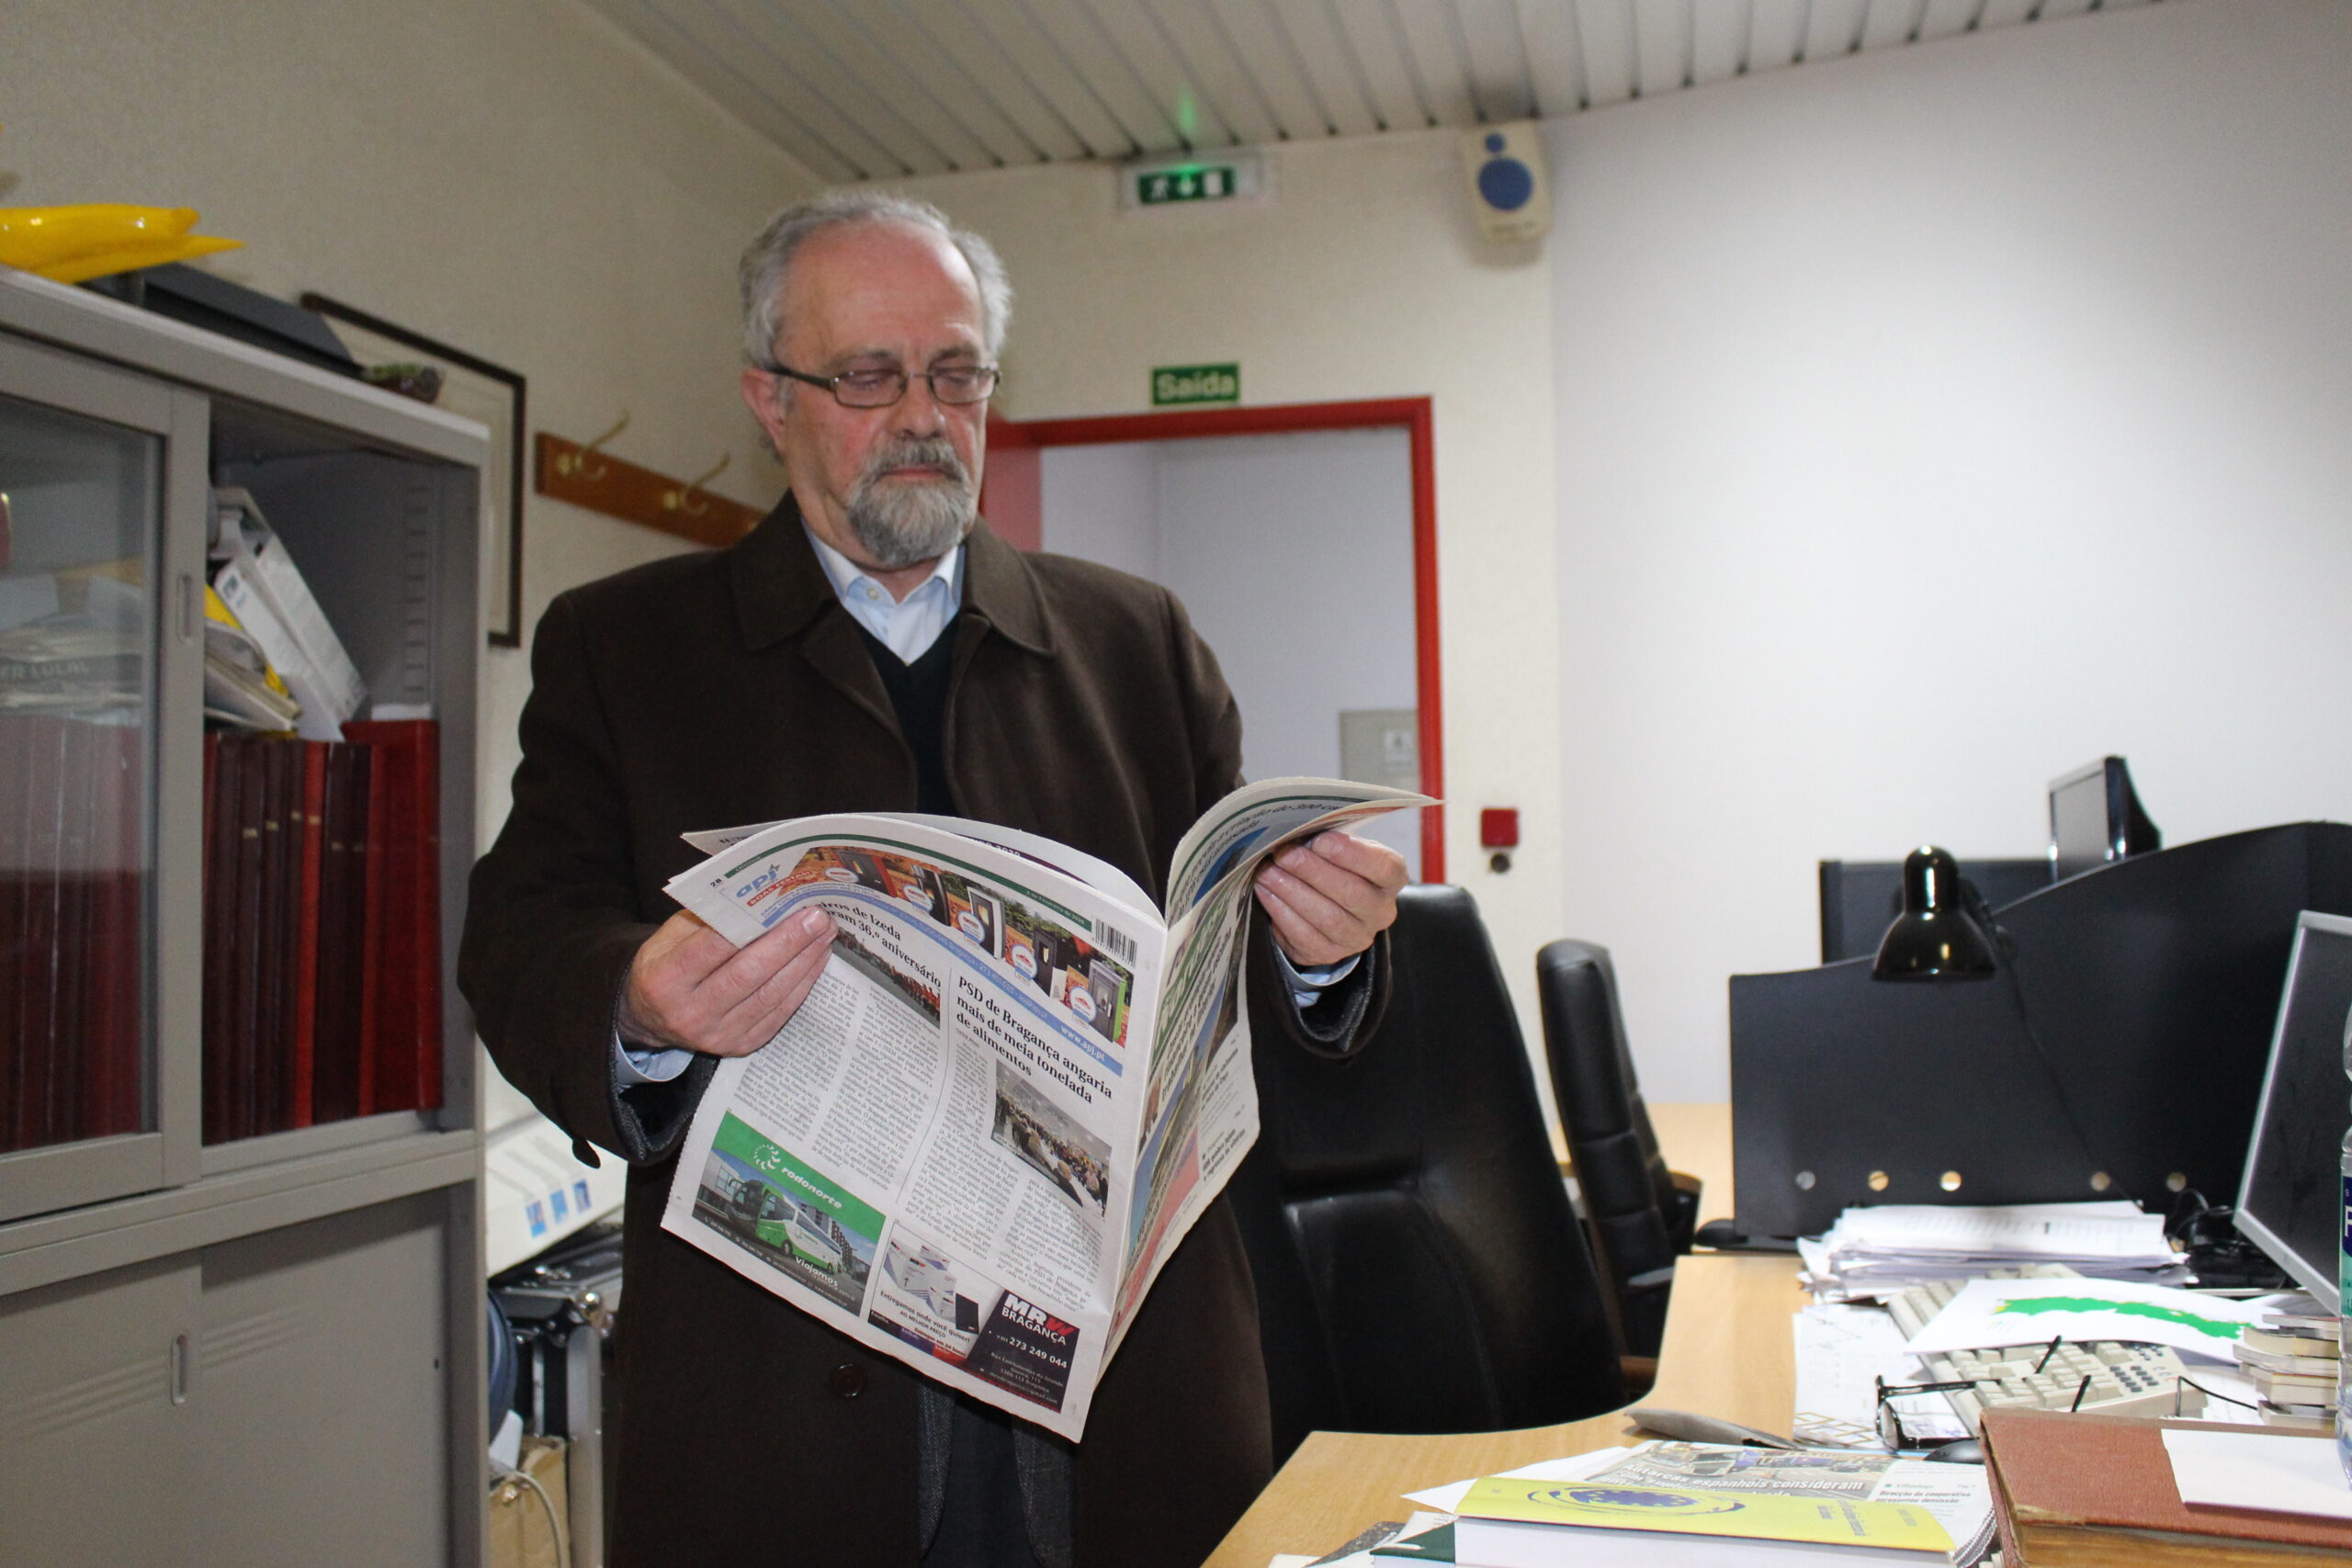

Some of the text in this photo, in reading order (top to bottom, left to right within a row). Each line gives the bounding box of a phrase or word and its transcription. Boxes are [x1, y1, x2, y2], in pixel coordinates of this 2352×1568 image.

[852, 906, 867, 918] de
[870, 912, 901, 942] Izeda
[882, 937, 942, 988] aniversário
[956, 1012, 971, 1028] de
[973, 1025, 1033, 1077] alimentos
[957, 997, 985, 1022] mais
[988, 1018, 1001, 1034] de
[1004, 1032, 1034, 1061] meia
[1037, 1056, 1092, 1104] tonelada
[959, 976, 983, 1003] PSD
[986, 998, 1000, 1015] de
[1003, 1012, 1060, 1062] Bragança
[1063, 1056, 1113, 1100] angaria
[1061, 1025, 1106, 1061] www.apj.pt
[782, 1167, 842, 1209] rodonorte
[796, 1256, 838, 1287] Viajamos
[880, 1290, 915, 1314] Entregamos
[916, 1311, 932, 1324] onde
[933, 1319, 947, 1330] você
[909, 1314, 929, 1330] MELHOR
[930, 1325, 946, 1338] PREÇO
[1001, 1307, 1067, 1346] BRAGANÇA
[1010, 1337, 1027, 1350] 273
[1029, 1347, 1047, 1359] 249
[1049, 1356, 1068, 1369] 044
[1772, 1477, 1864, 1491] consideram
